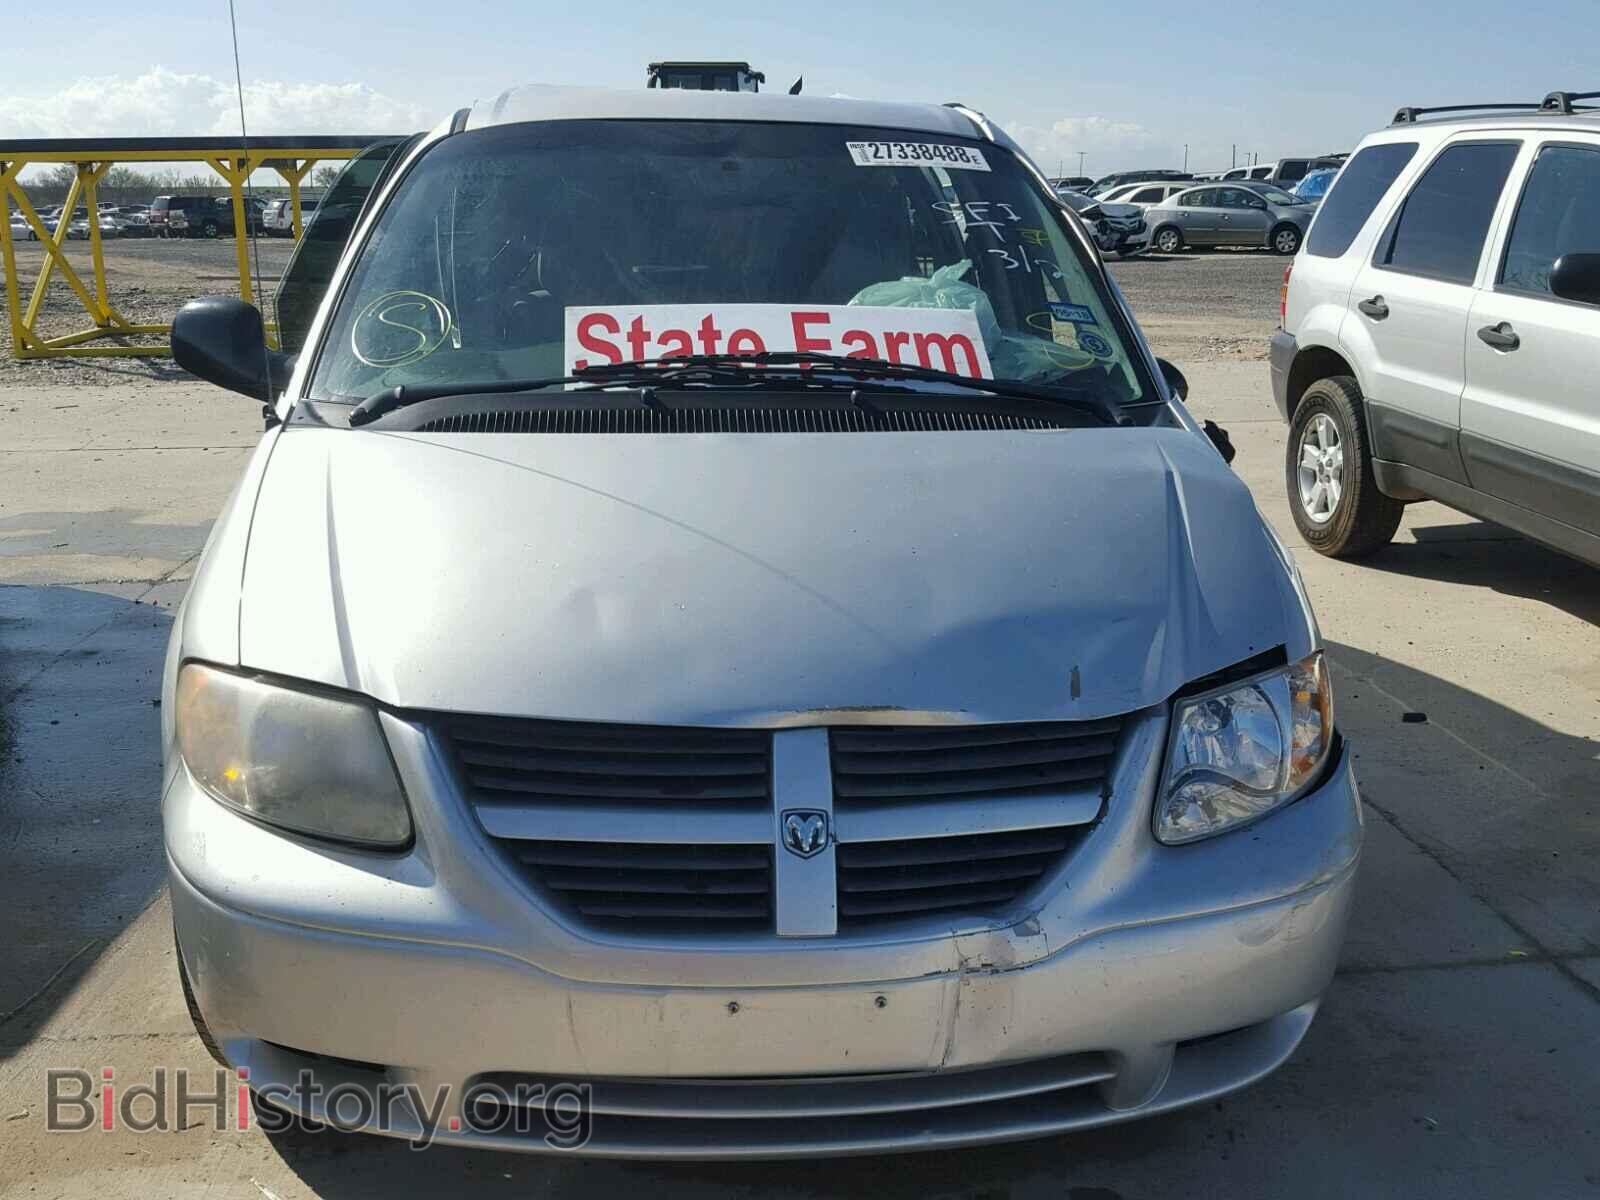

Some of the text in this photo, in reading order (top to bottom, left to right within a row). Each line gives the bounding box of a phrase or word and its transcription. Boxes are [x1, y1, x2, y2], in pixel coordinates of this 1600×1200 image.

[867, 142, 971, 164] 27338488
[575, 311, 982, 379] State Farm
